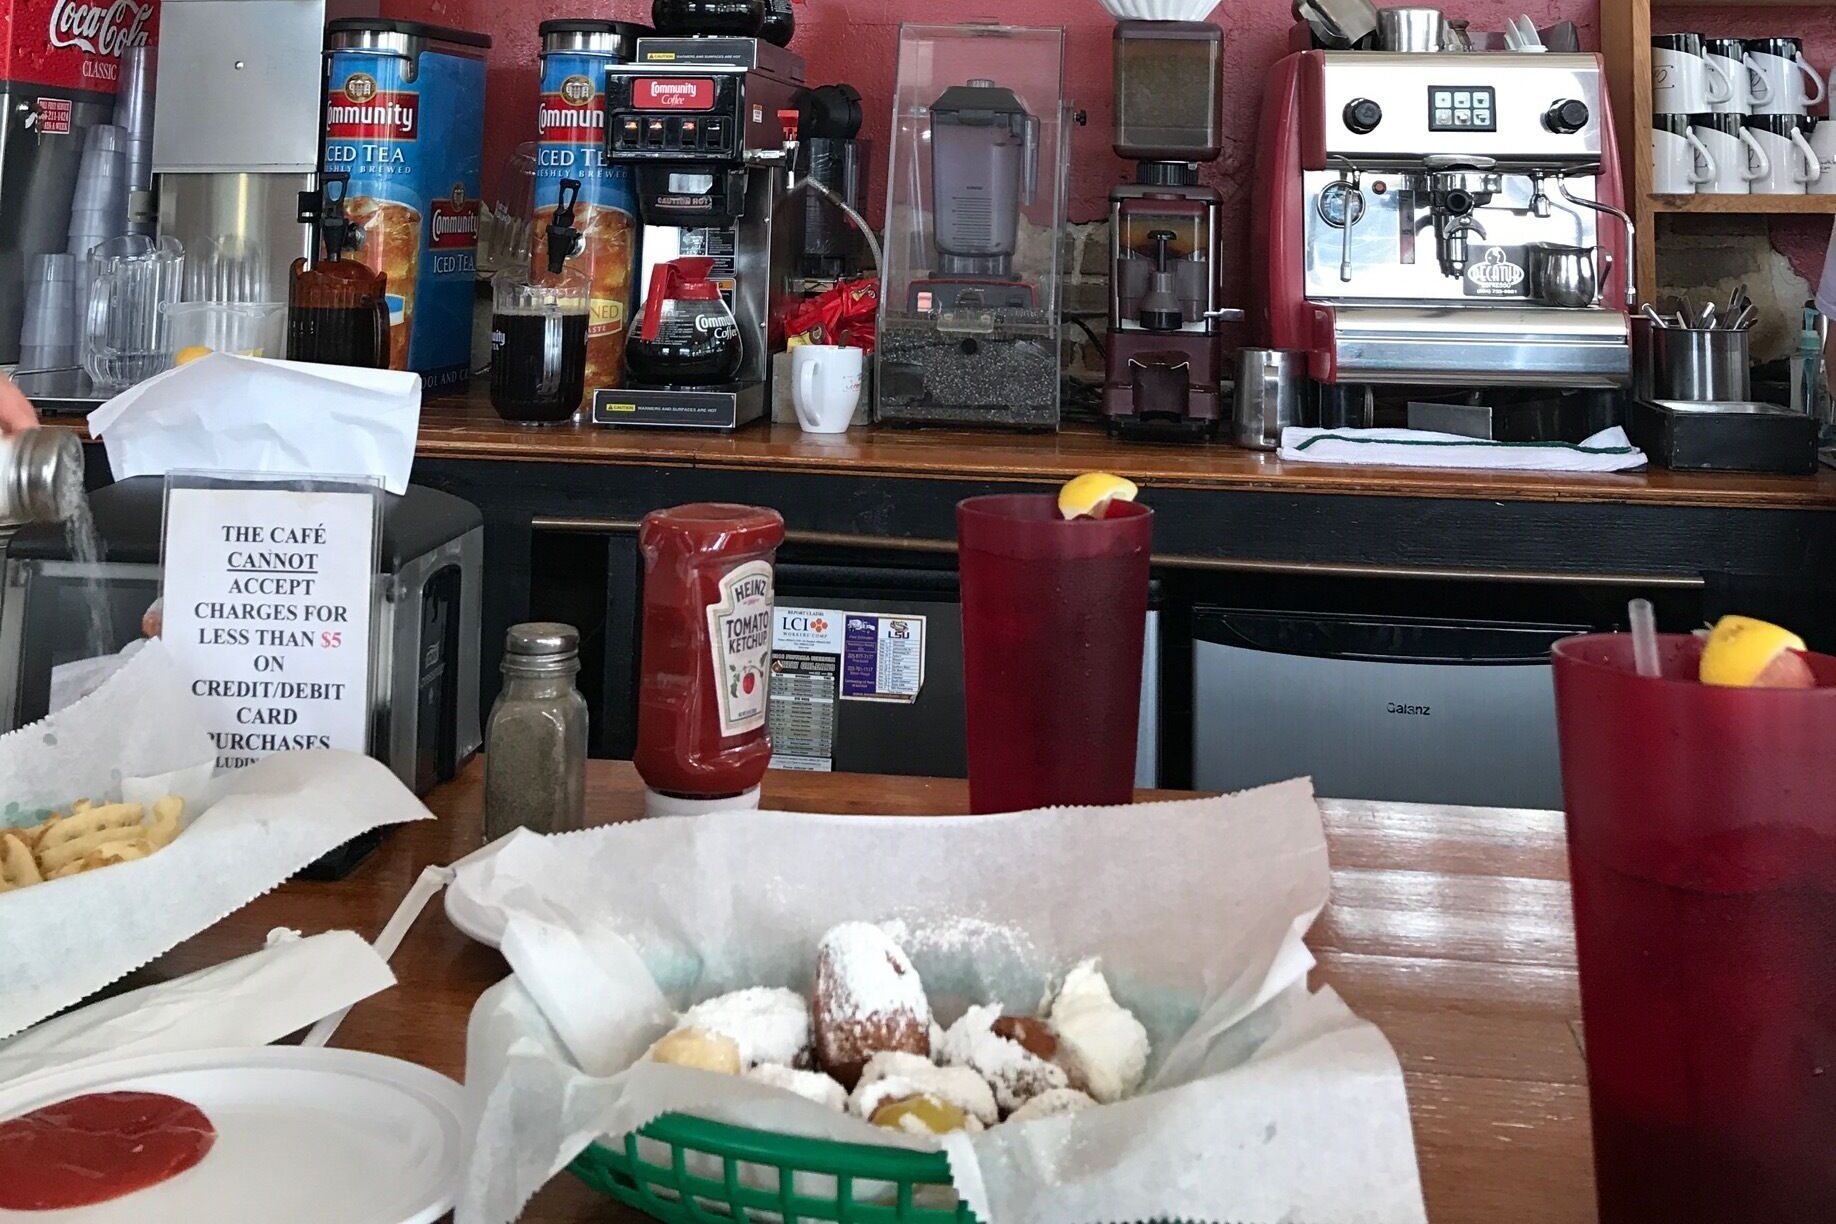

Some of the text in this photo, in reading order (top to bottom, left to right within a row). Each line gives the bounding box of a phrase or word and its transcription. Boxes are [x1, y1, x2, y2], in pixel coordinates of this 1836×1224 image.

[82, 60, 118, 81] CLASSIC
[650, 81, 697, 97] Community
[661, 94, 686, 106] Coffee
[327, 101, 413, 132] ommunity
[538, 102, 605, 135] Commun
[326, 144, 405, 163] CED TEA
[537, 148, 608, 167] ICED TE
[360, 165, 412, 174] BREWED
[432, 209, 479, 242] Community
[433, 255, 456, 273] ICED
[695, 314, 737, 333] Commu
[222, 523, 327, 545] THE CAFÉ
[227, 551, 319, 570] CANNOT
[228, 578, 315, 596] ACCEPT
[734, 578, 767, 603] HEINZ
[194, 602, 348, 623] CHARGES FOR
[726, 611, 769, 639] TOMATO
[782, 616, 809, 631] LCI
[198, 627, 342, 648] LESS THAN $5
[728, 630, 768, 654] KETCHUP
[888, 631, 910, 640] LSU
[253, 655, 285, 673] ON
[191, 679, 346, 701] CREDIT/DEBIT
[236, 707, 298, 725] CARD
[1386, 702, 1431, 716] Galanz
